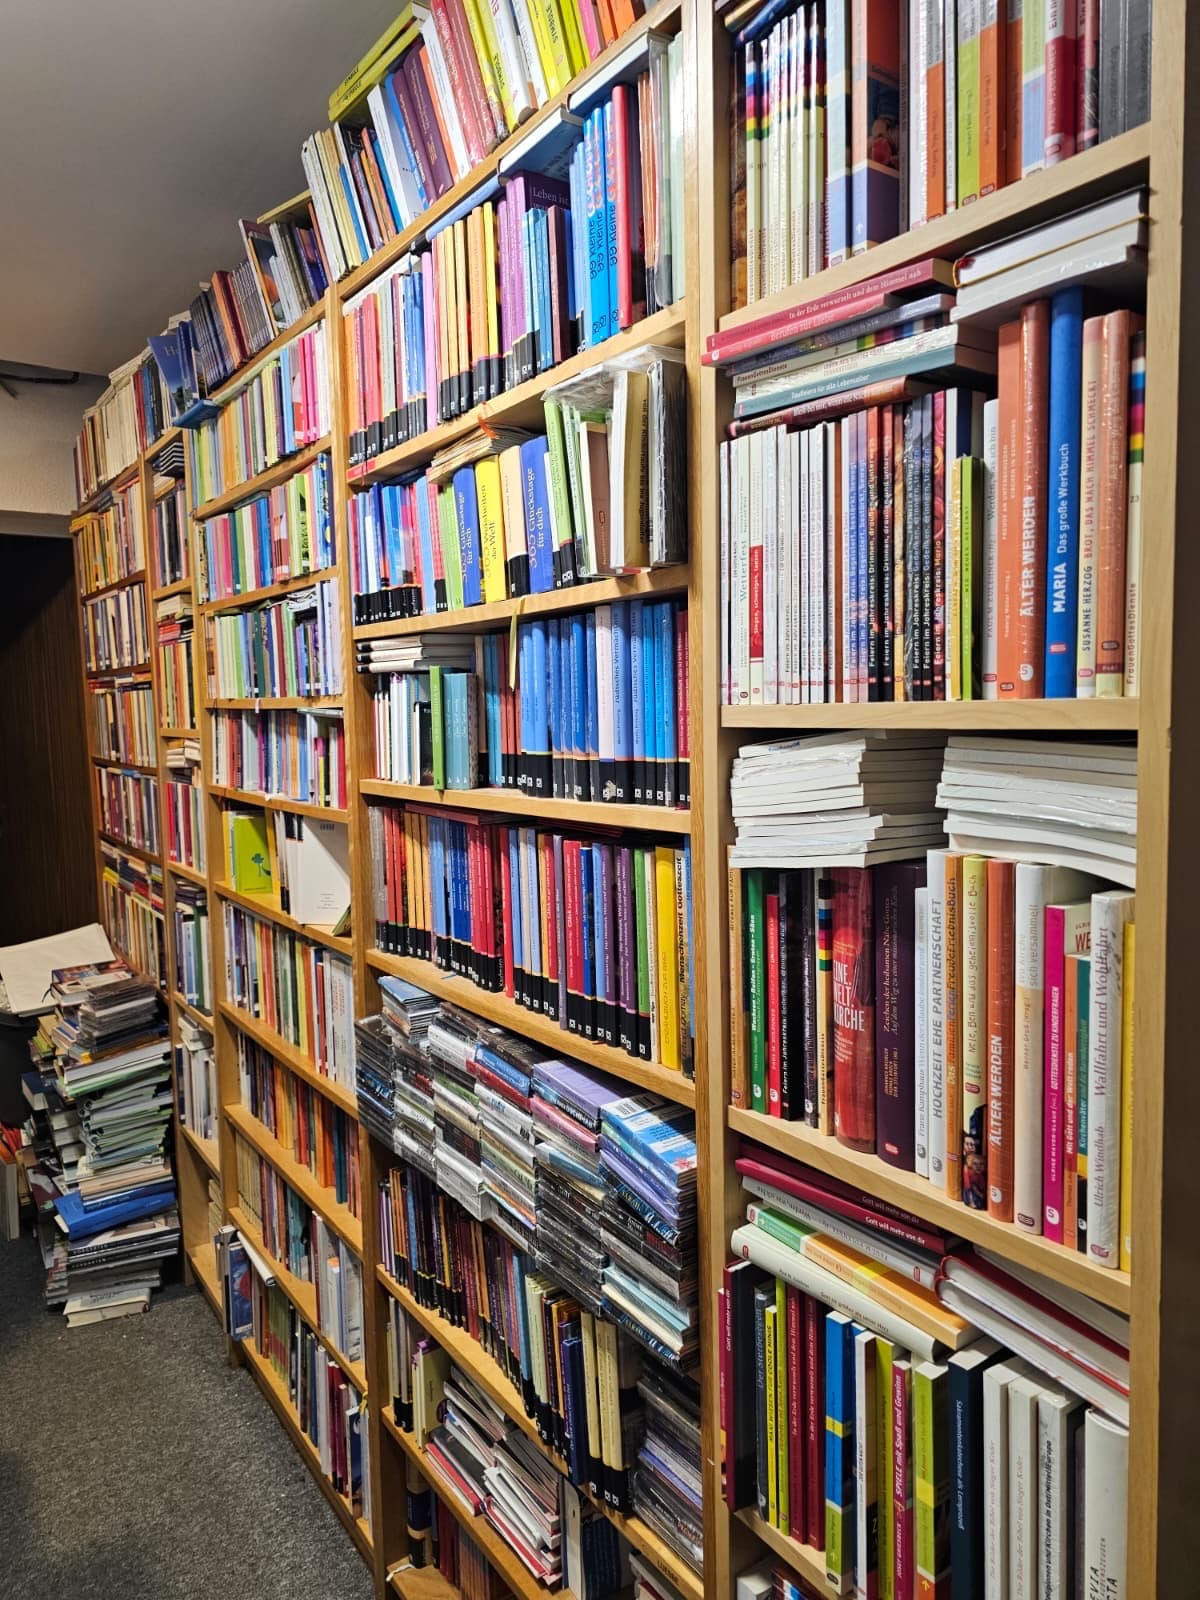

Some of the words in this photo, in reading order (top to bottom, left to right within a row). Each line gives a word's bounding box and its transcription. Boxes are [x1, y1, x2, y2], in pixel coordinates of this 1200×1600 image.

[533, 187, 557, 202] Leben
[608, 204, 618, 242] kleine
[853, 288, 865, 298] und
[866, 285, 879, 295] dem
[1087, 380, 1097, 429] SCHMECKT
[986, 426, 996, 441] bin
[1086, 435, 1096, 472] HIMMEL
[1058, 444, 1070, 498] Werkbuch
[526, 468, 538, 532] Glückstage
[986, 480, 996, 520] Werden,
[1085, 477, 1095, 500] NACH
[536, 506, 544, 530] dich
[1058, 500, 1070, 530] große
[1085, 508, 1094, 524] DAS
[466, 527, 474, 548] dich
[488, 522, 498, 546] Welt
[536, 532, 544, 548] für
[1021, 497, 1036, 565] WERDEN
[1057, 534, 1067, 553] Das
[1084, 529, 1094, 559] BROT,
[868, 538, 876, 574] Drinnen,
[882, 535, 890, 572] Drinnen,
[738, 540, 750, 602] Wetterfest
[1082, 566, 1092, 604] HERZOG
[868, 574, 876, 626] Jahreskreis:
[882, 572, 890, 626] Jahreskreis:
[912, 574, 920, 626] Jahreskreis:
[922, 572, 930, 626] Jahreskreis:
[1019, 568, 1035, 616] ÄLTER
[1052, 562, 1066, 614] MARIA
[1082, 608, 1092, 652] SUSANNE
[1126, 582, 1136, 684] FrauenGottesDienste
[868, 640, 876, 667] Feiern
[882, 640, 890, 666] Feiern
[912, 640, 920, 668] Feiern
[922, 640, 930, 668] Feiern
[675, 857, 683, 908] Gotteszeit
[968, 874, 978, 896] Buch
[677, 912, 686, 983] Menschenzeit
[1028, 904, 1038, 962] versammelt
[932, 898, 942, 1014] PARTNERSCHAFT
[1096, 927, 1110, 996] Wohlfahrt
[968, 975, 978, 991] das
[1028, 966, 1038, 986] sich
[882, 987, 890, 1000] der
[882, 1000, 890, 1032] Zeichen
[968, 1012, 978, 1028] Ben
[1050, 986, 1060, 1034] KINDERFRAGEN
[1096, 1002, 1108, 1028] und
[932, 1020, 942, 1046] EHE
[968, 1030, 978, 1053] Nele,
[990, 1035, 1003, 1097] WERDEN
[1050, 1042, 1060, 1090] GOTTESDIENSTE
[1064, 1052, 1074, 1076] reden
[1095, 1032, 1107, 1096] Wallfahrt
[932, 1050, 942, 1118] HOCHZEIT
[1064, 1076, 1074, 1094] Welt
[988, 1100, 1002, 1146] ÄLTER
[1064, 1105, 1074, 1123] und
[1078, 1100, 1088, 1148] Kirchenväter
[1064, 1124, 1074, 1140] Gott
[1064, 1142, 1074, 1154] Mit
[1095, 1175, 1105, 1206] Ulrich
[865, 1215, 878, 1226] Gott
[879, 1221, 889, 1231] will
[890, 1226, 904, 1236] mehr
[905, 1233, 916, 1241] von
[916, 1236, 925, 1245] dir
[790, 1338, 798, 1351] dem
[790, 1352, 798, 1366] und
[894, 1374, 904, 1406] Gewinn
[894, 1408, 904, 1426] und
[894, 1426, 904, 1448] Spaß
[894, 1450, 904, 1464] mit
[894, 1466, 904, 1496] SPIELE
[1016, 1505, 1024, 1520] von
[1016, 1521, 1024, 1542] Bibel
[1016, 1544, 1024, 1556] der
[1016, 1558, 1024, 1580] Bilder
[1016, 1582, 1024, 1596] Die
